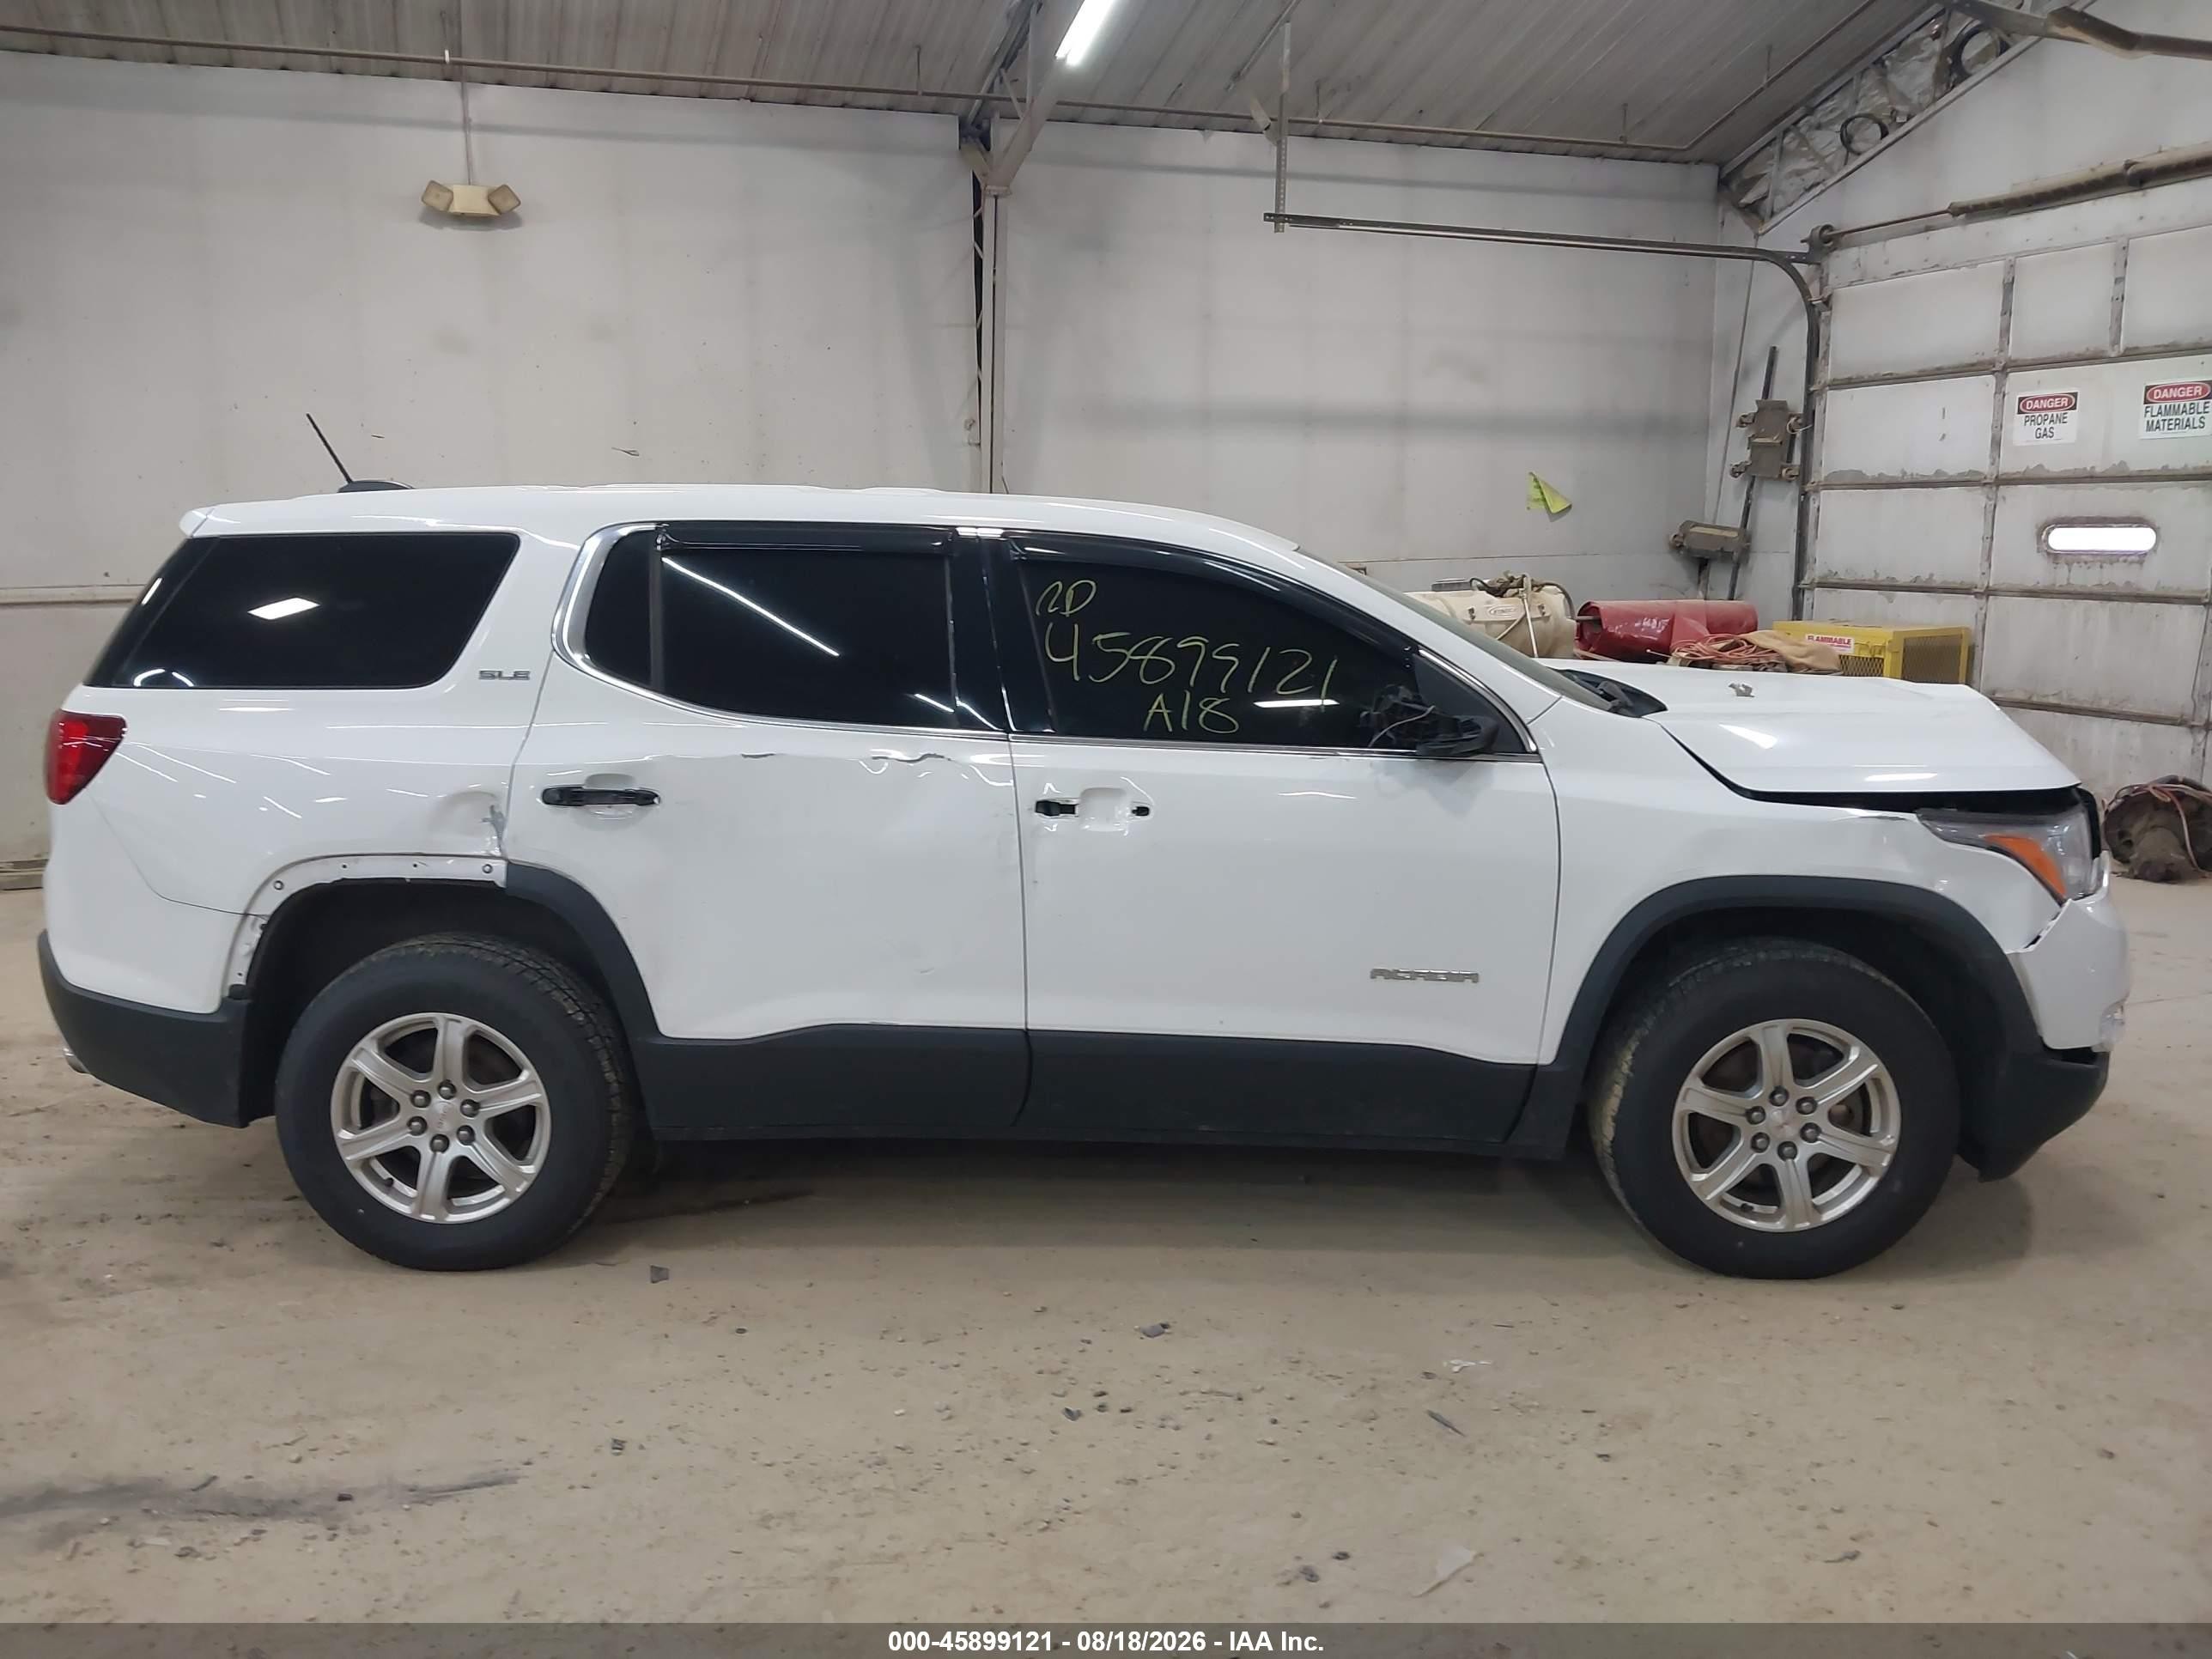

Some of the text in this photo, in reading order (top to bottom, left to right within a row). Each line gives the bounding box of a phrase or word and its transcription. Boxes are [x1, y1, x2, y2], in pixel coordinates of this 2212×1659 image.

[2152, 386, 2203, 399] DANGER
[2026, 398, 2069, 410] DANGER
[2144, 401, 2210, 417] FLAMMABLE
[2024, 412, 2068, 426] PROPANE
[2146, 416, 2206, 432] MATERIALS
[2034, 426, 2055, 439] GAS
[1044, 622, 1338, 713] 45899121
[478, 670, 531, 680] SLE
[1144, 690, 1239, 734] A18
[1370, 968, 1479, 983] ACADIA
